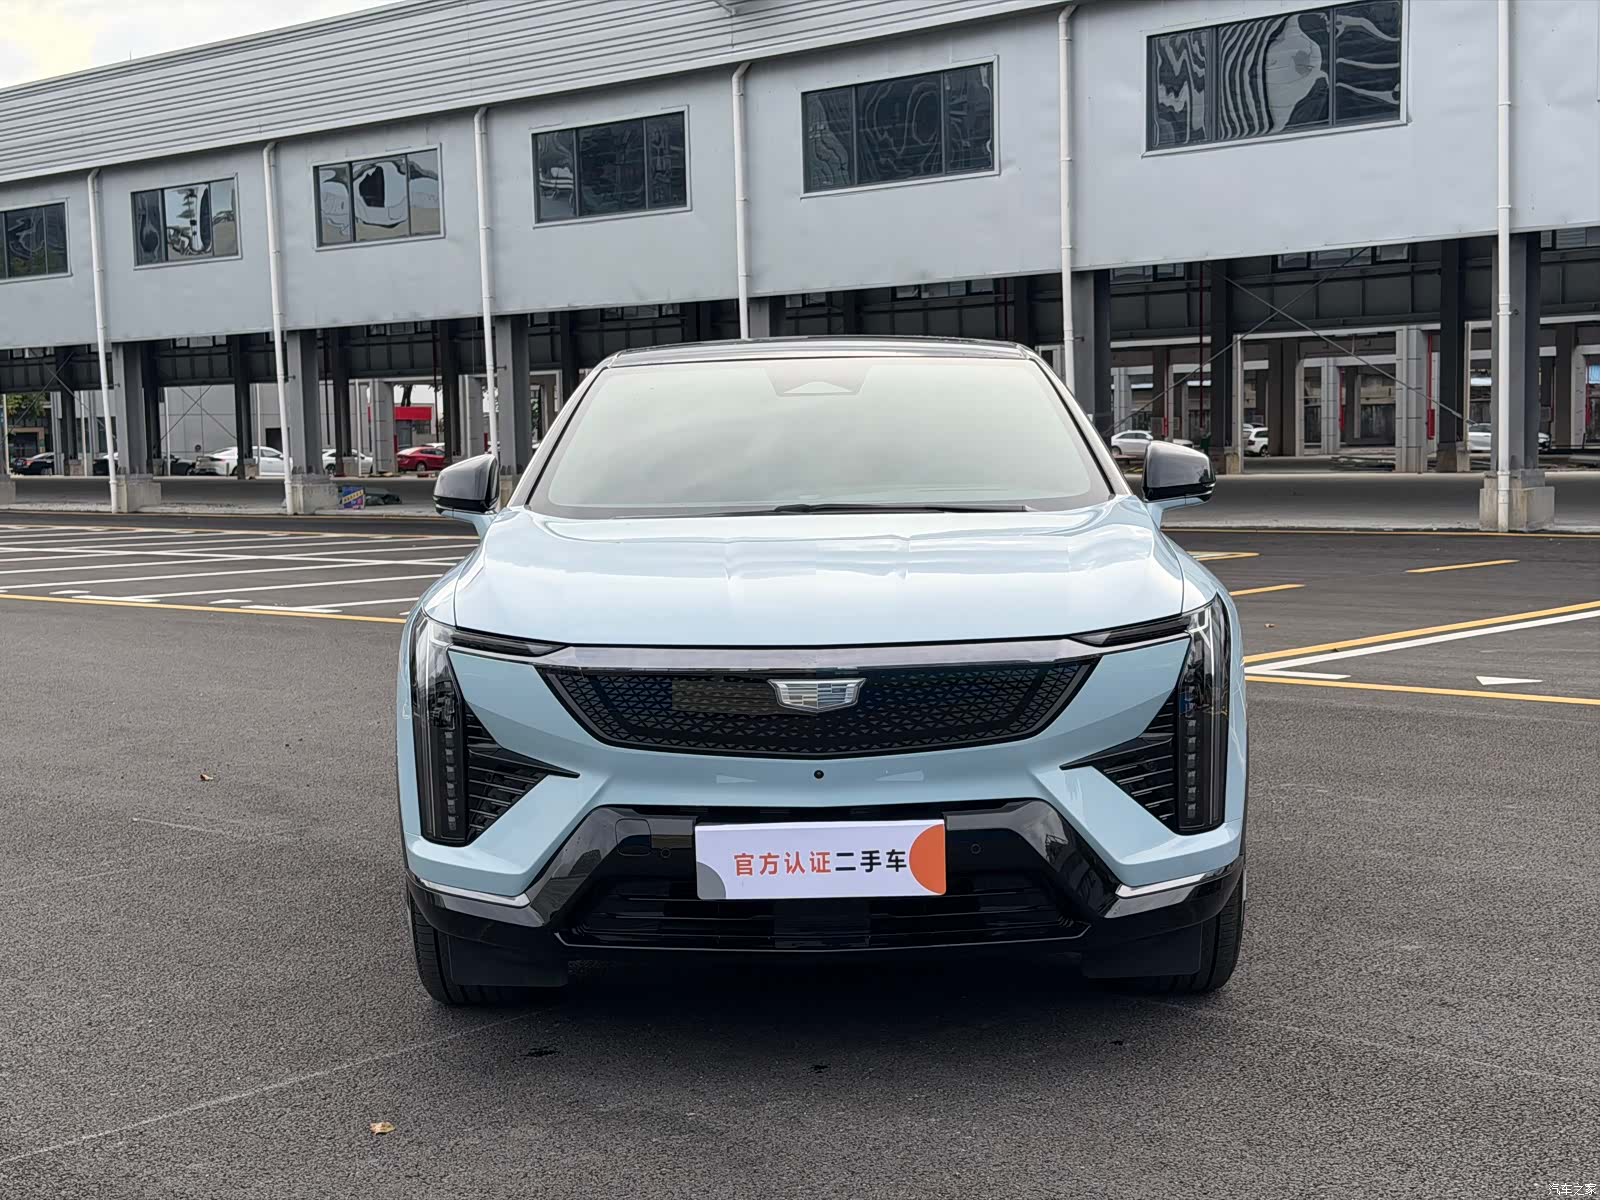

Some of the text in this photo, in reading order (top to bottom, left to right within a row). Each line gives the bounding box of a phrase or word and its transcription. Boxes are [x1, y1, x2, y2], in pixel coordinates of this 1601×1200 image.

[734, 849, 907, 876] 官方认证二手车
